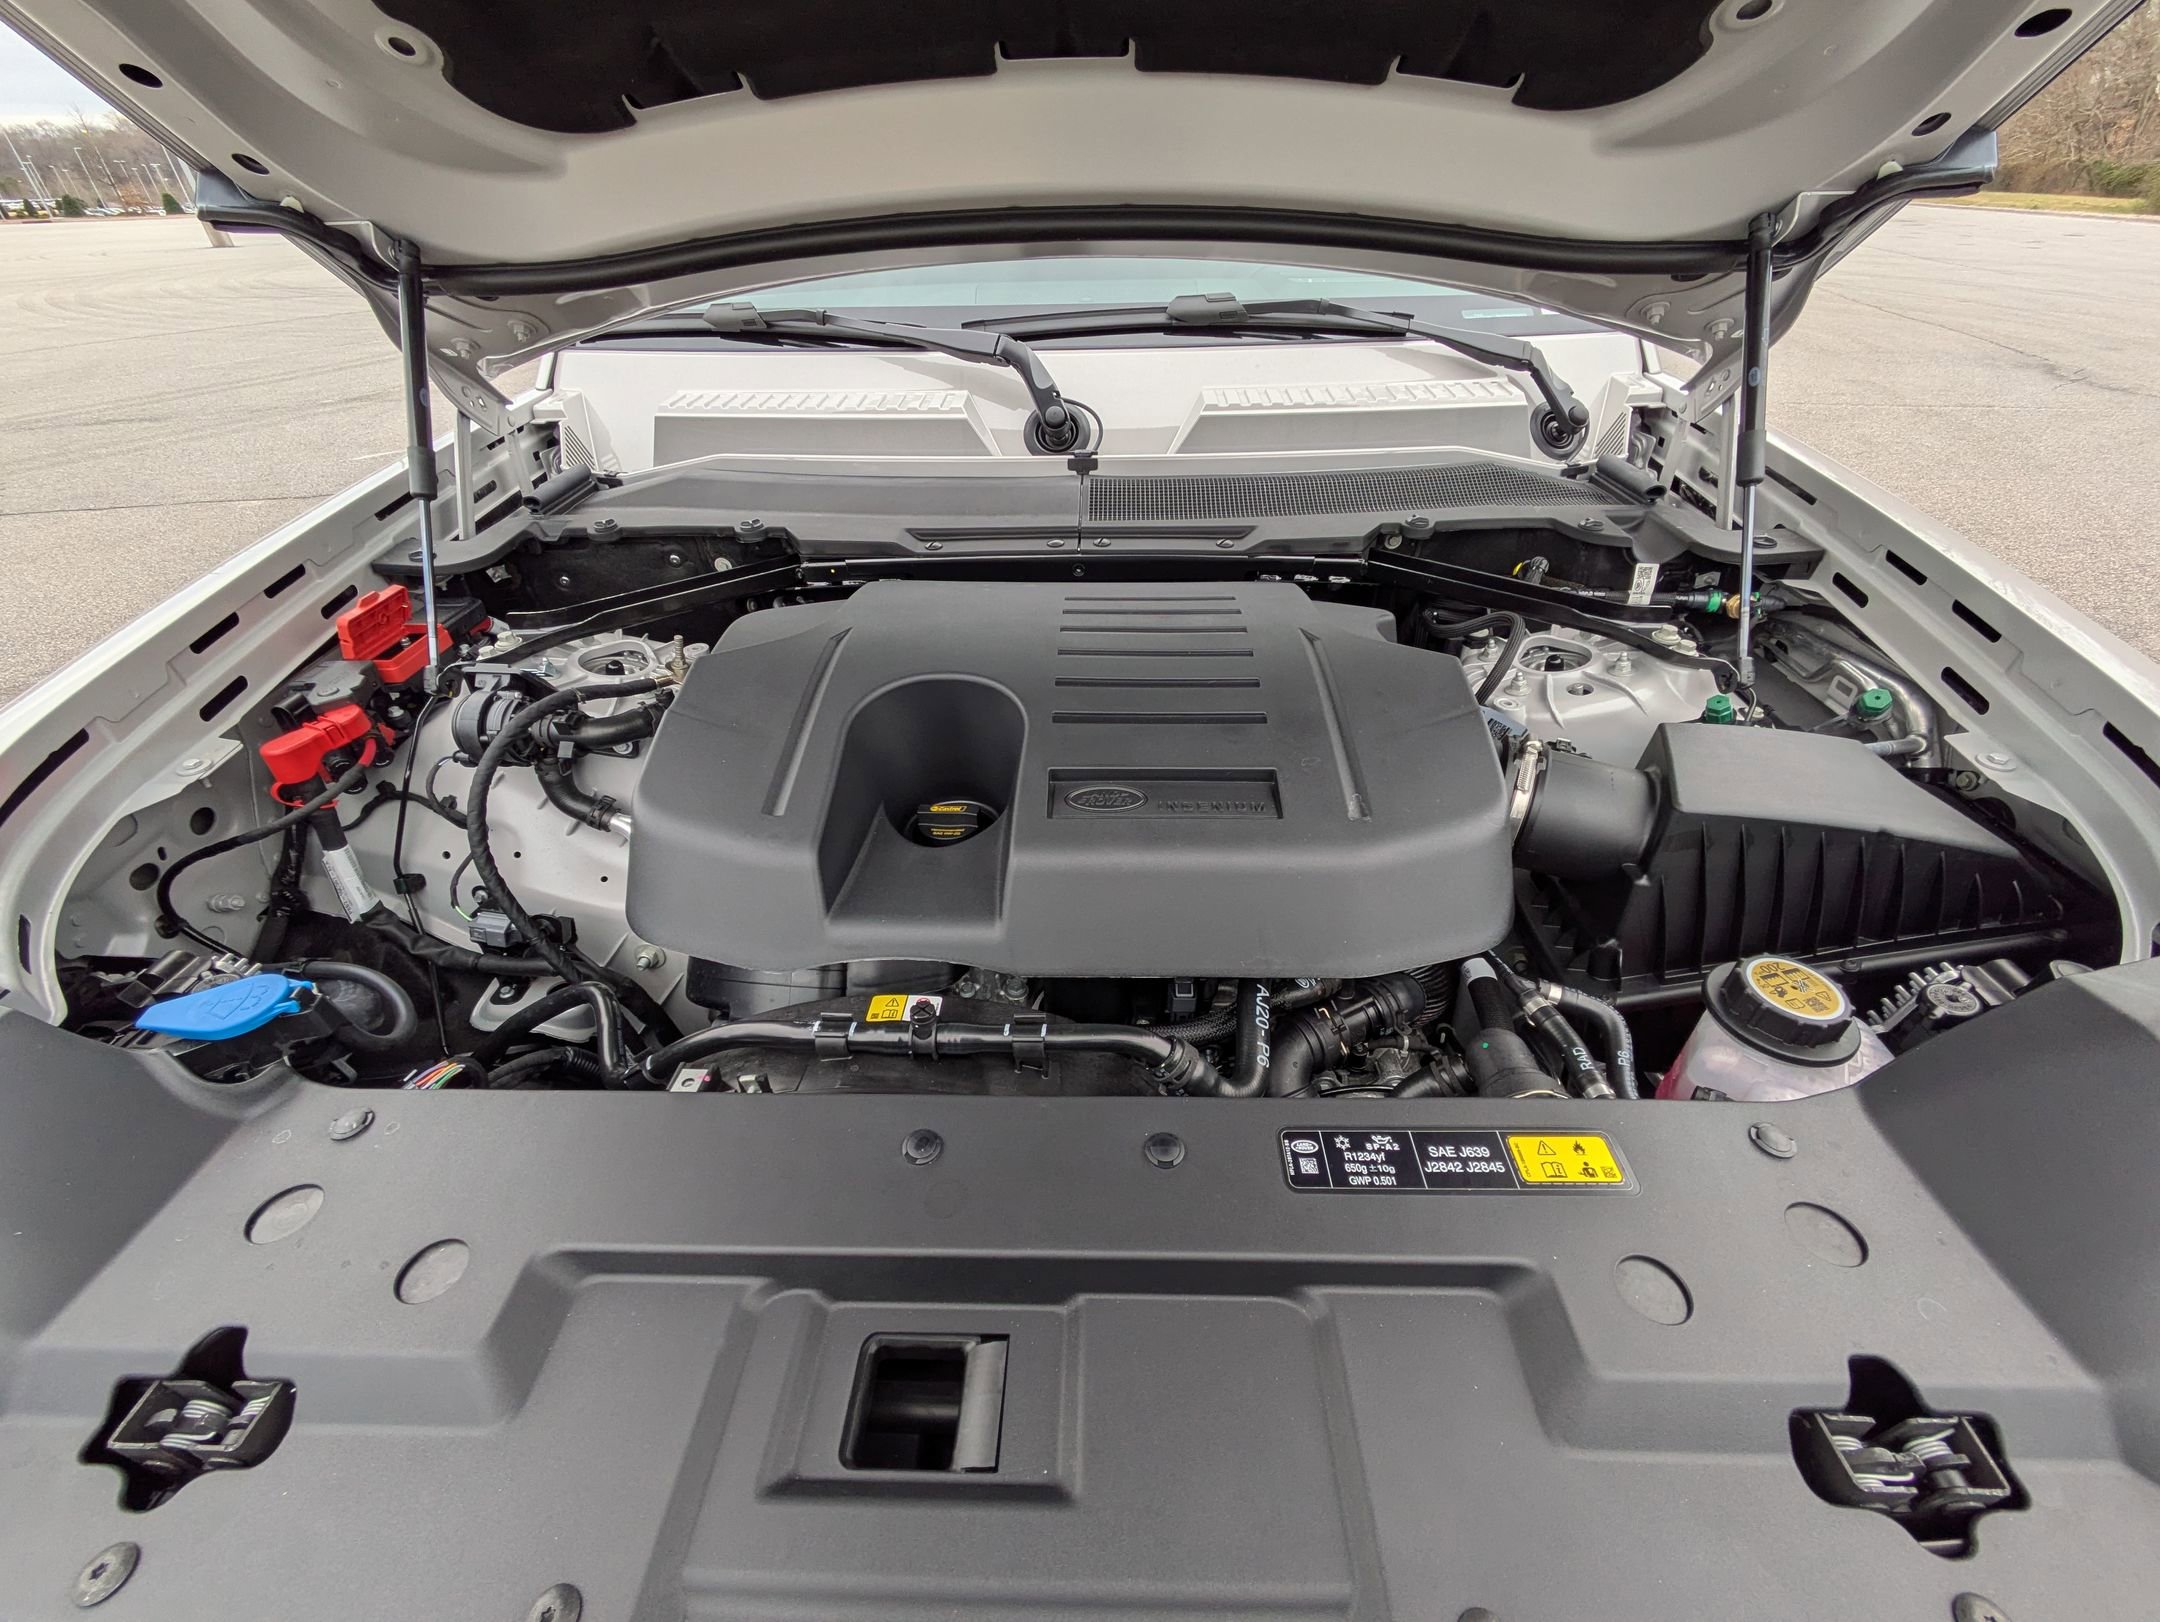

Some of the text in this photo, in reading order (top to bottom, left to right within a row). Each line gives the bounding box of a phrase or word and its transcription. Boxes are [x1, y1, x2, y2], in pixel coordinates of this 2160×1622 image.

[1257, 1041, 1270, 1068] P6
[1572, 1046, 1595, 1071] RAD
[1617, 1050, 1631, 1067] P6
[1365, 1143, 1400, 1151] SP-A2
[1428, 1146, 1490, 1158] SAE J639
[1344, 1152, 1386, 1163] R1234yf
[1344, 1163, 1396, 1175] 650g ±10g
[1424, 1161, 1505, 1173] J2842 J2845
[1348, 1176, 1397, 1186] GWP 0.501
